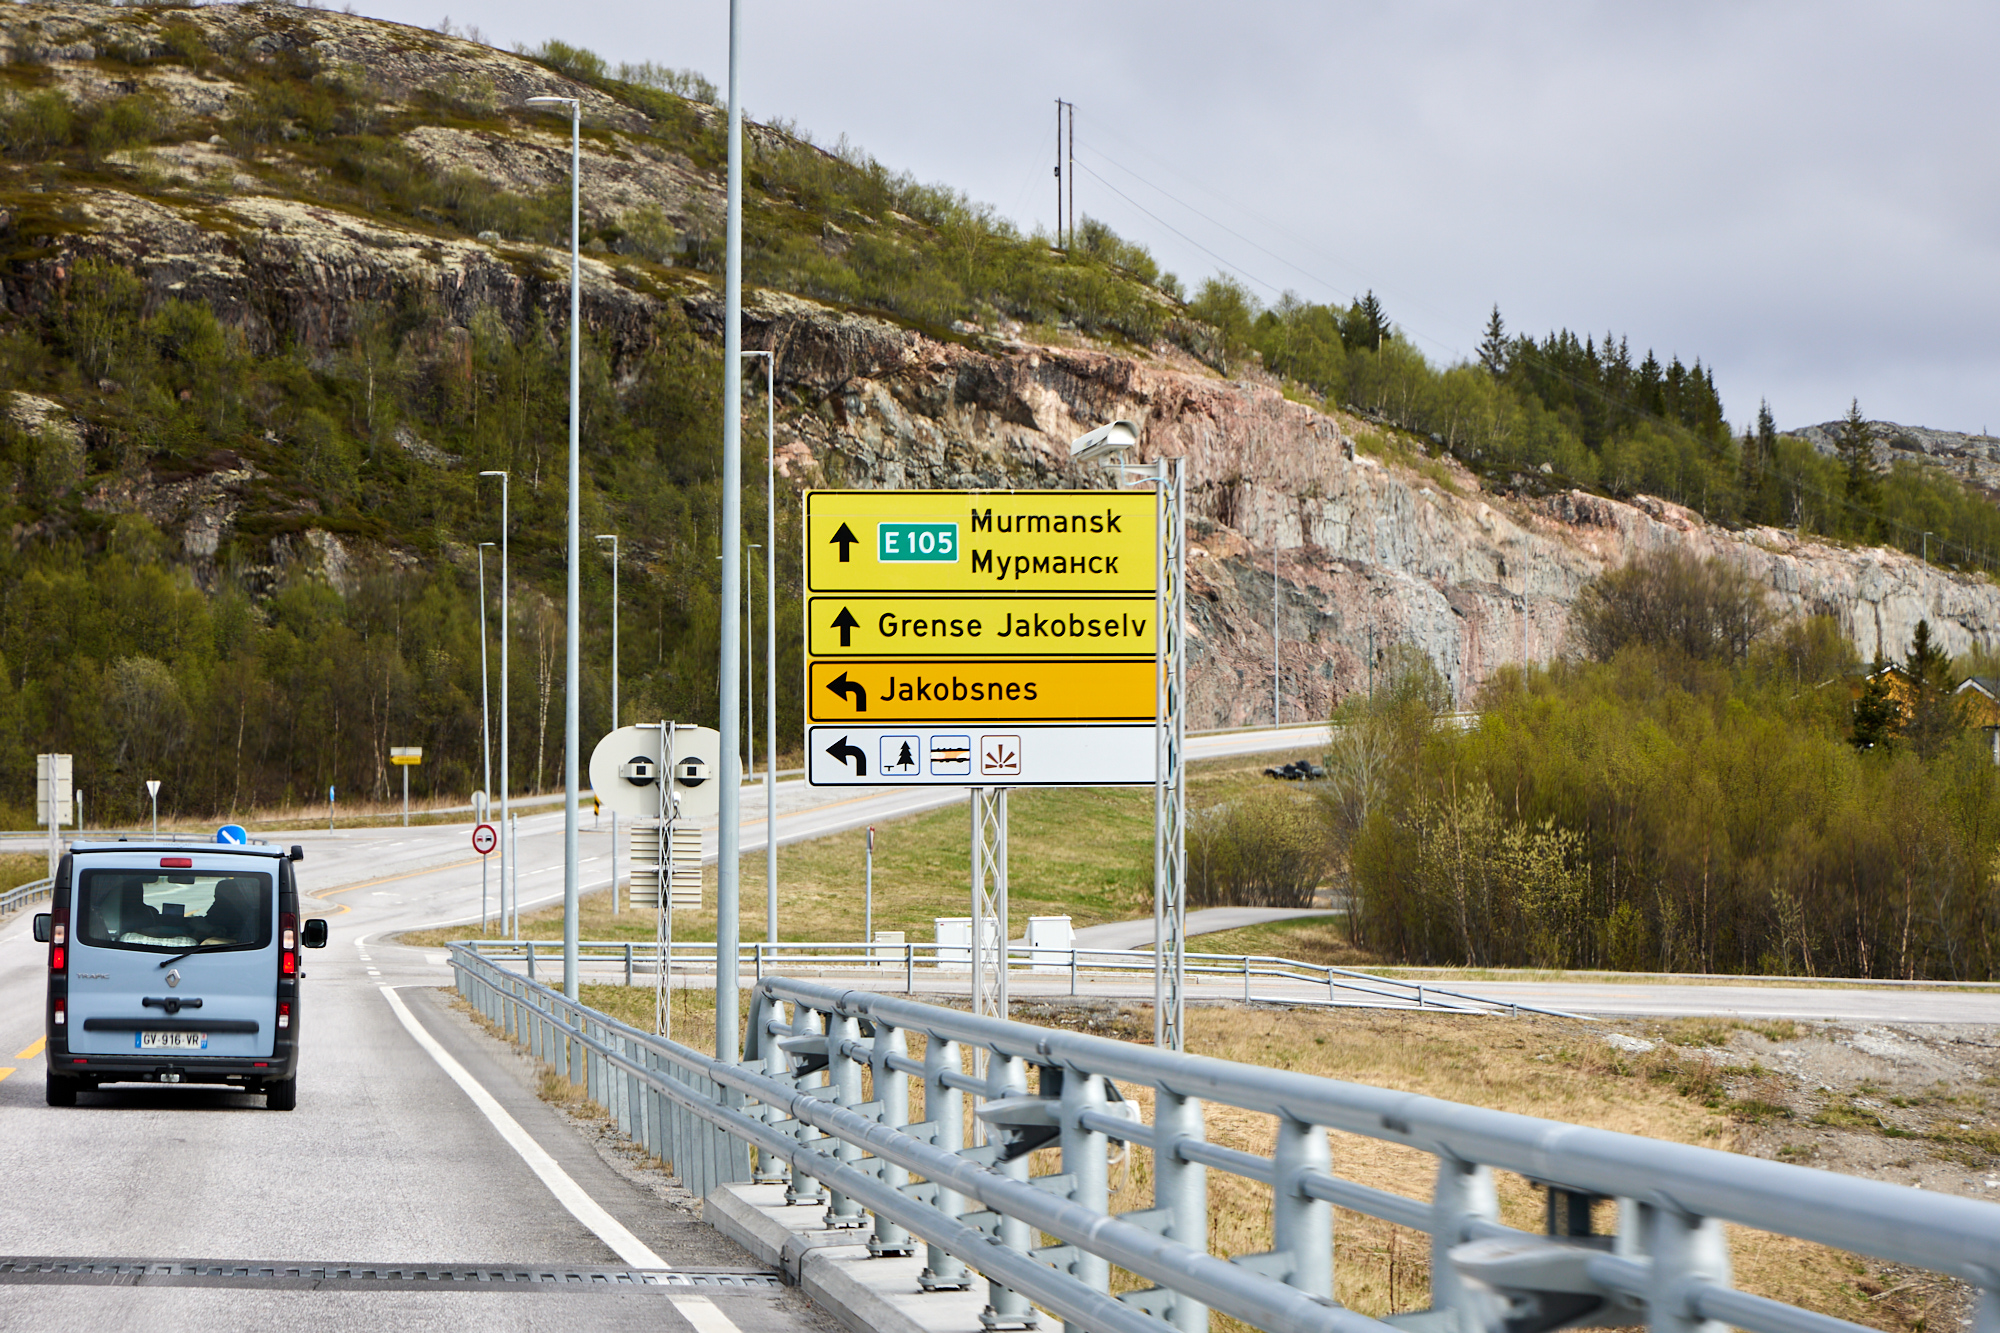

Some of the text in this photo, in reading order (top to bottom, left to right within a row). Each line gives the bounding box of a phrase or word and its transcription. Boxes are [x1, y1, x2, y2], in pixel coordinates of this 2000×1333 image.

[972, 508, 1122, 533] Murmansk
[885, 531, 953, 554] E 105
[972, 549, 1119, 580] Мурманск
[879, 612, 1147, 638] Grense Jakobselv
[880, 676, 1038, 702] Jakobsnes
